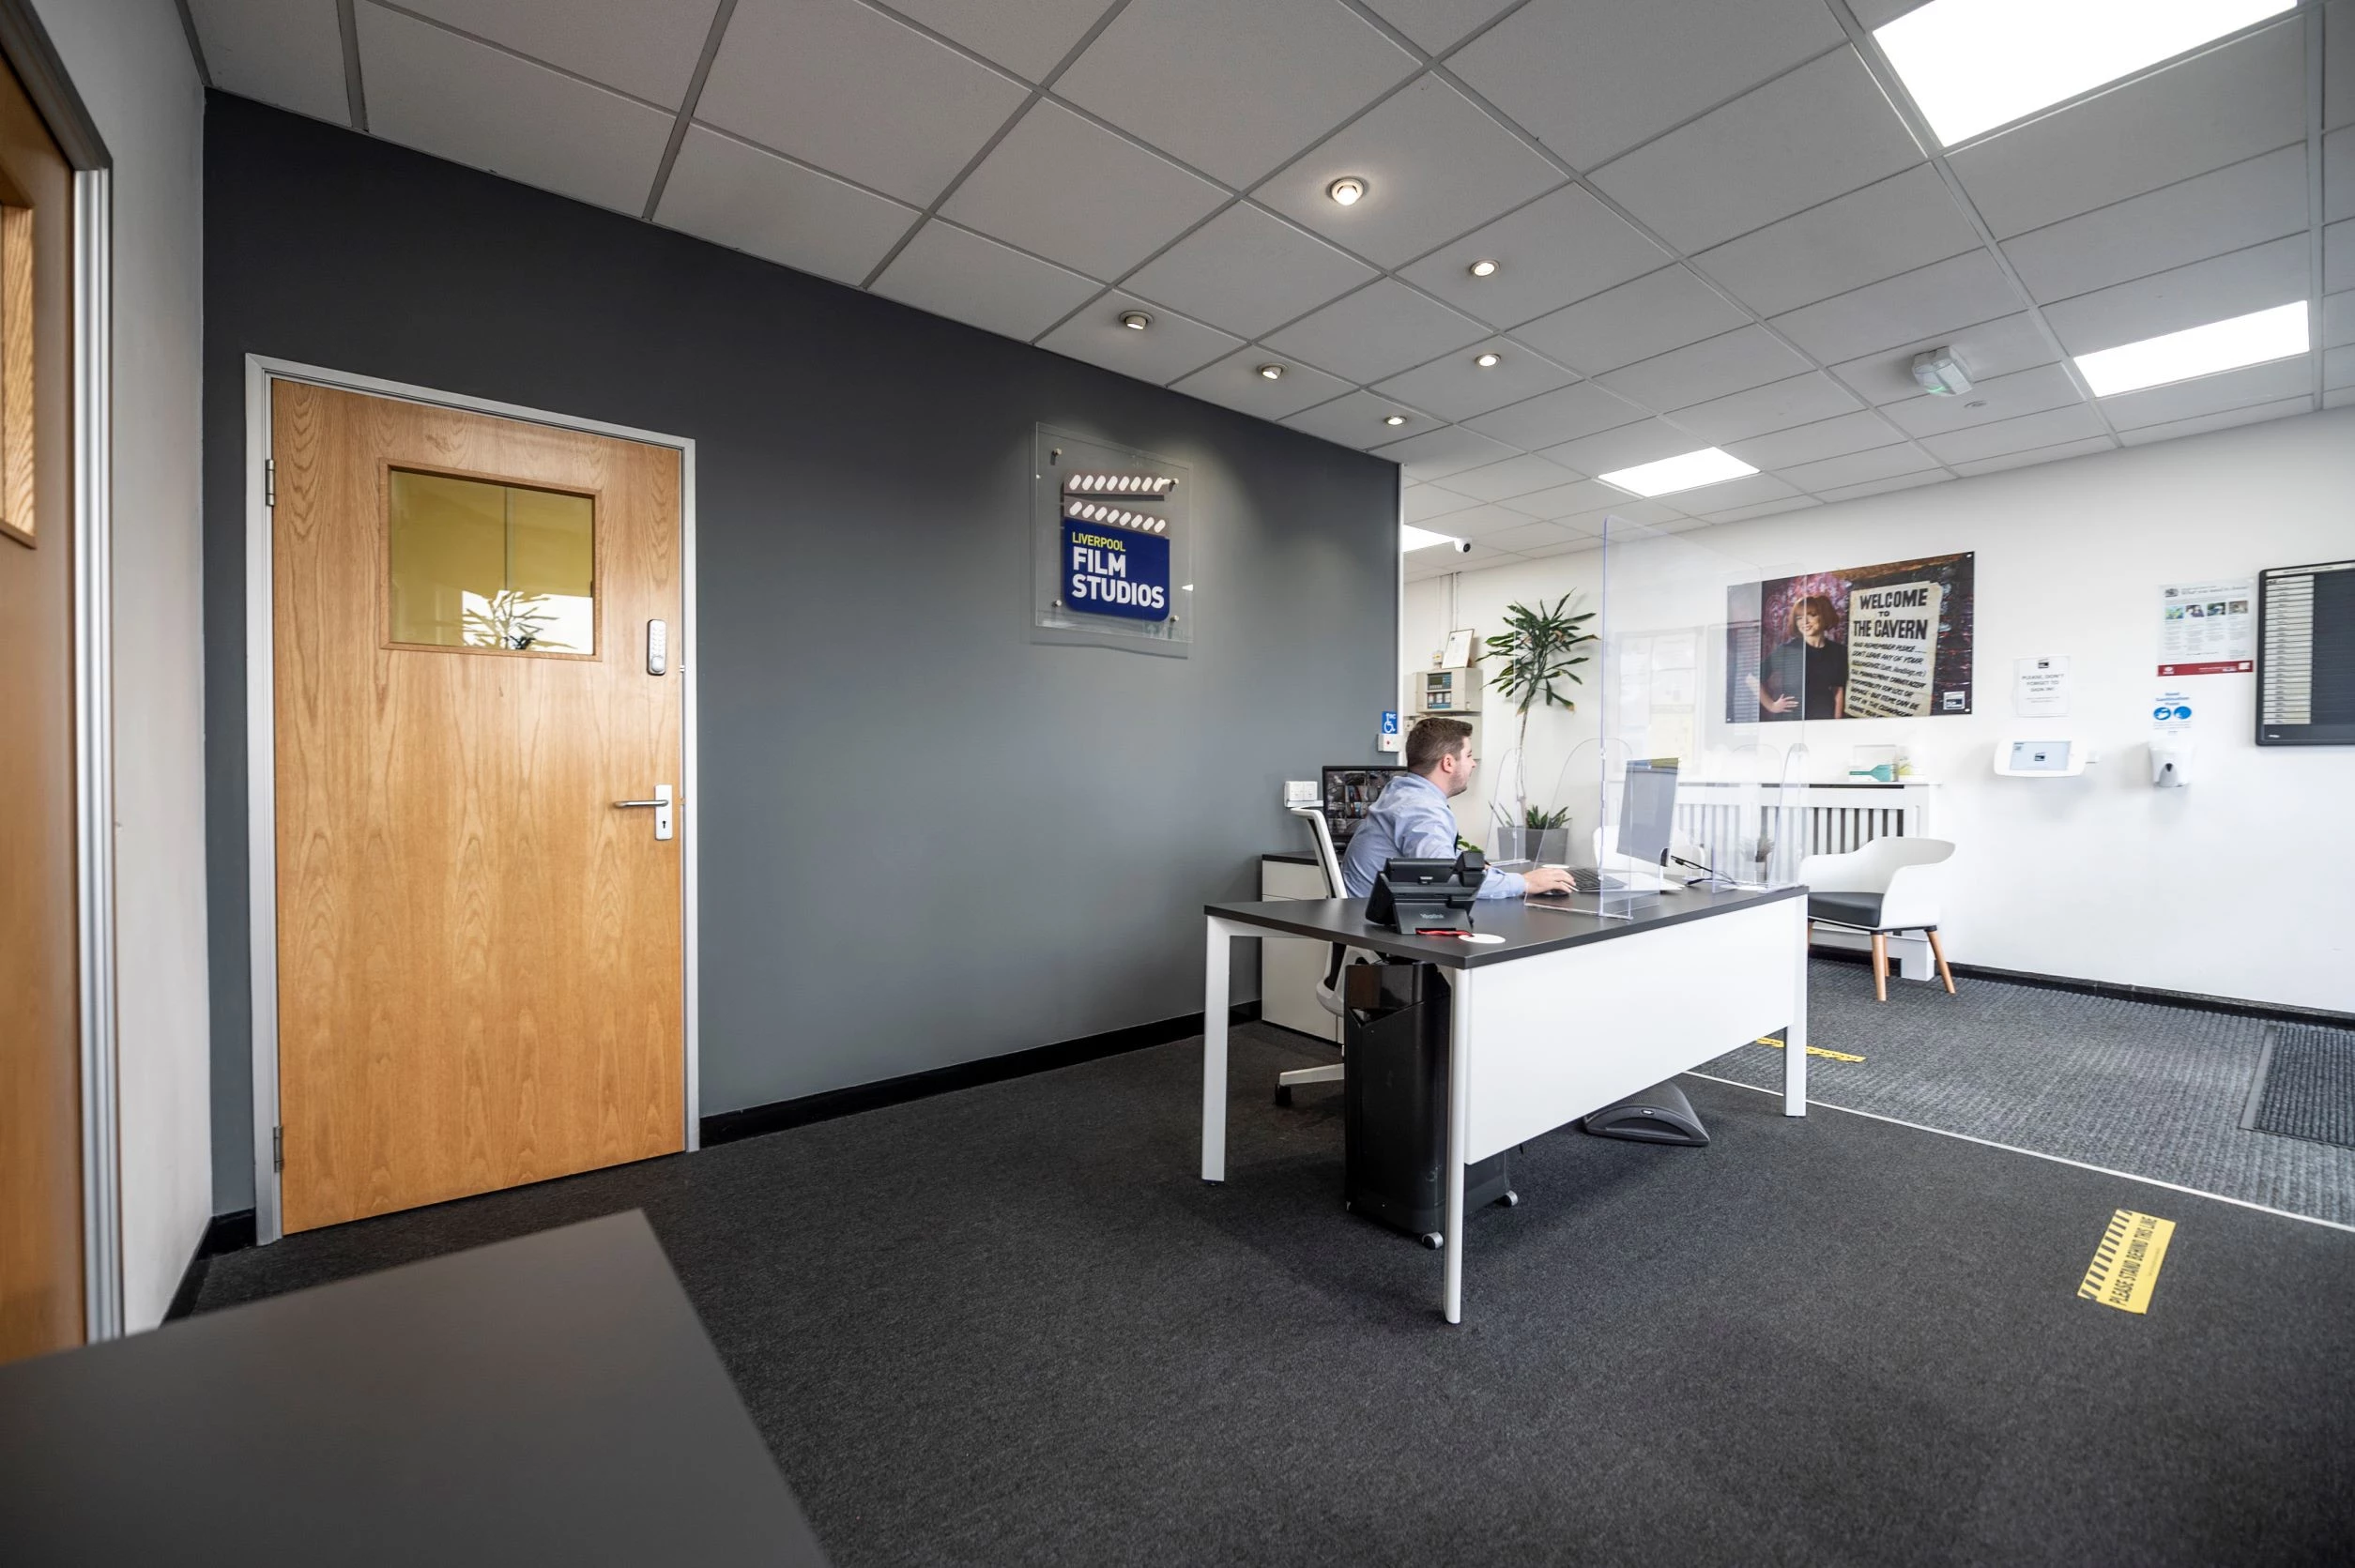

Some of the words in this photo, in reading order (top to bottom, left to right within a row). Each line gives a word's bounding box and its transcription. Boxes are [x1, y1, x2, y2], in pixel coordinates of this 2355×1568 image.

[1072, 532, 1126, 552] LIVERPOOL
[1073, 546, 1126, 578] FILM
[1072, 574, 1165, 609] STUDIOS
[1859, 588, 1928, 609] WELCOME
[1854, 620, 1872, 637] THE
[1874, 619, 1928, 640] CAVERN
[2133, 1227, 2154, 1241] THIS
[2126, 1239, 2149, 1261] BEHIND
[2118, 1259, 2141, 1281] STAND
[2109, 1279, 2134, 1306] PLEASE
